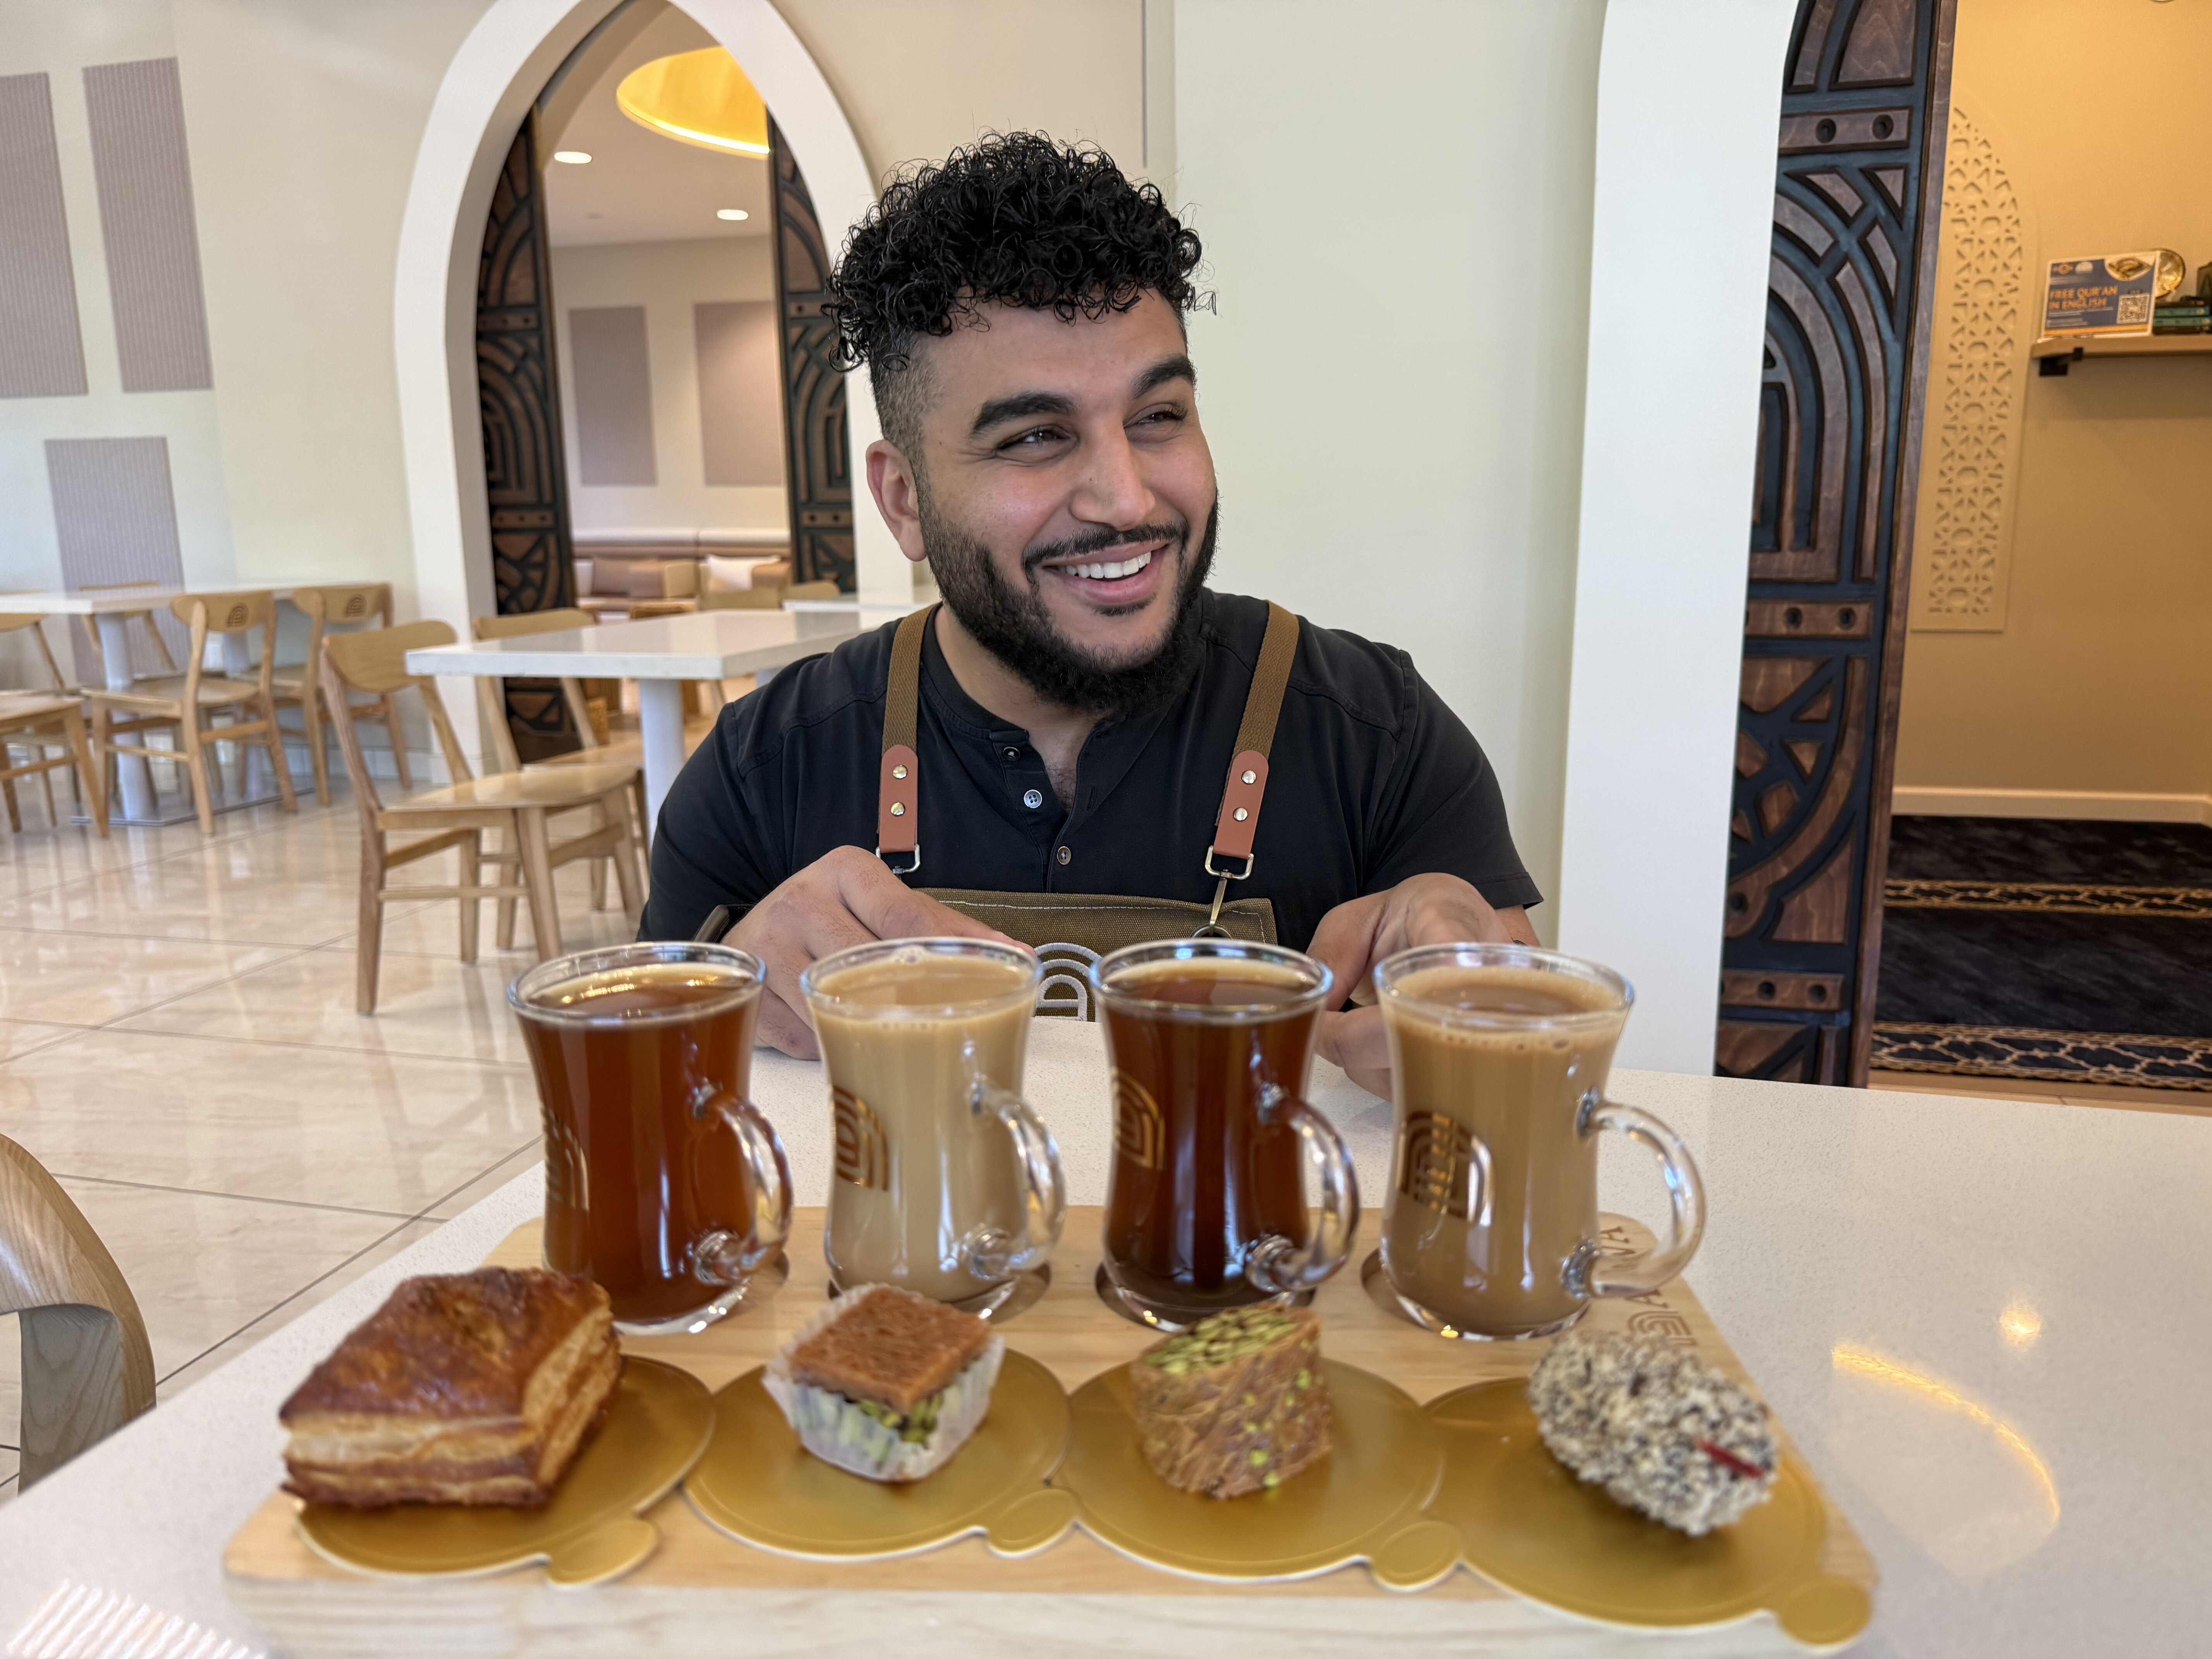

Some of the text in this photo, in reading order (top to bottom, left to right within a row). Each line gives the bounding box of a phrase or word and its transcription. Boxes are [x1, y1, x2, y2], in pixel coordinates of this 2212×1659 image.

[2050, 289, 2075, 299] FREE
[2077, 285, 2118, 298] QUR'AN
[2062, 297, 2107, 309] ENGLISH
